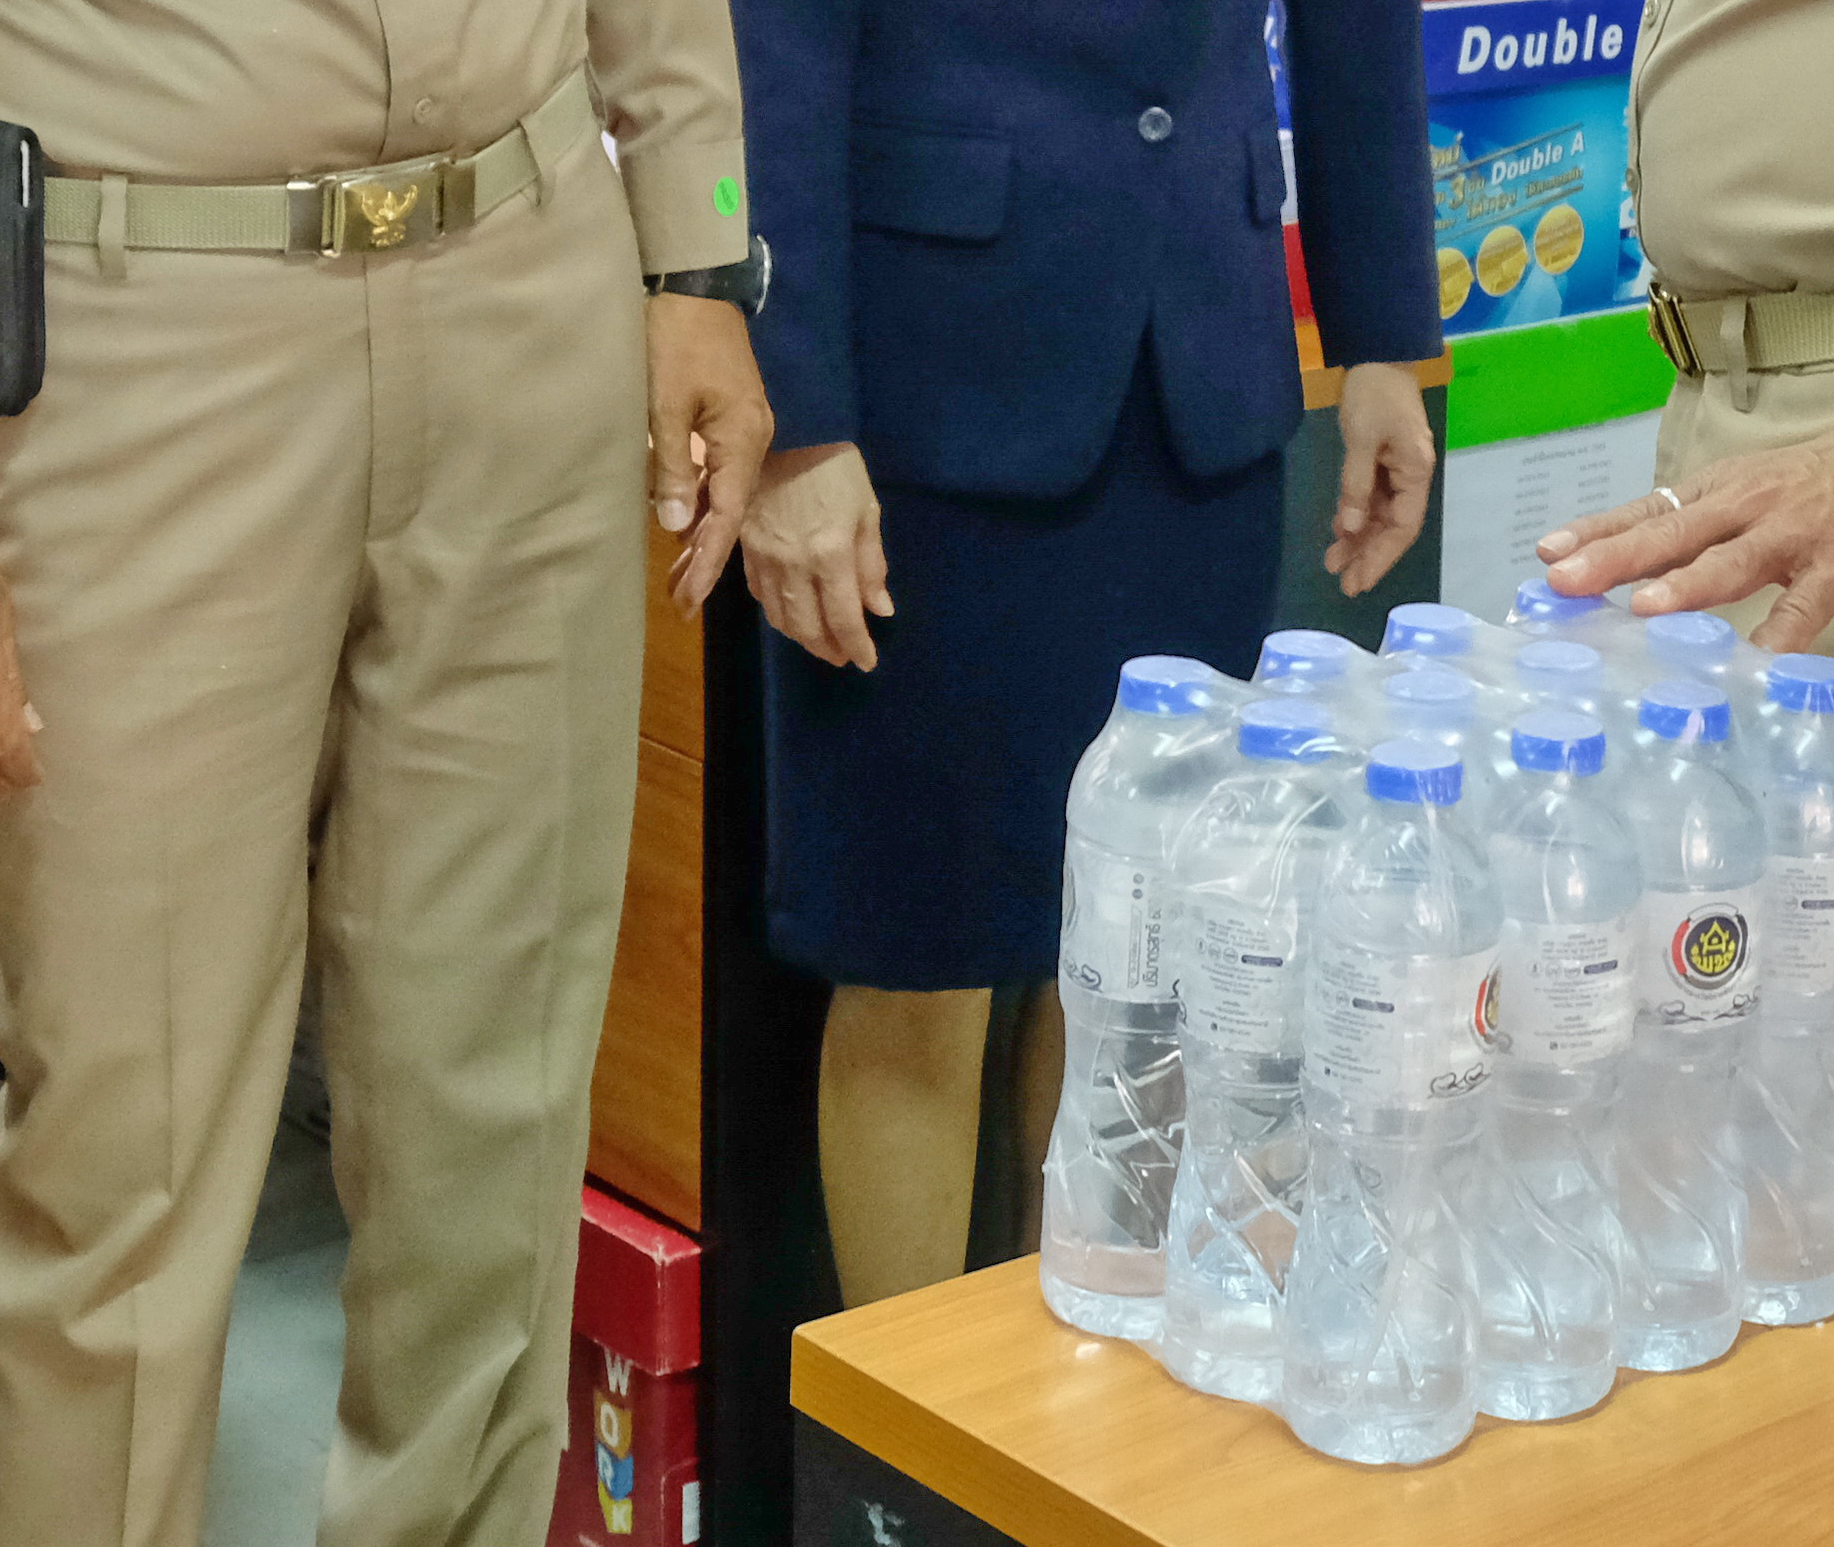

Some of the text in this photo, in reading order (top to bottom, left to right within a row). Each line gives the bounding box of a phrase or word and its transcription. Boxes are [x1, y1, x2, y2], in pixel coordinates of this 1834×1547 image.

[1457, 14, 1623, 76] Double
[1490, 139, 1564, 187] Double
[1569, 131, 1586, 156] A
